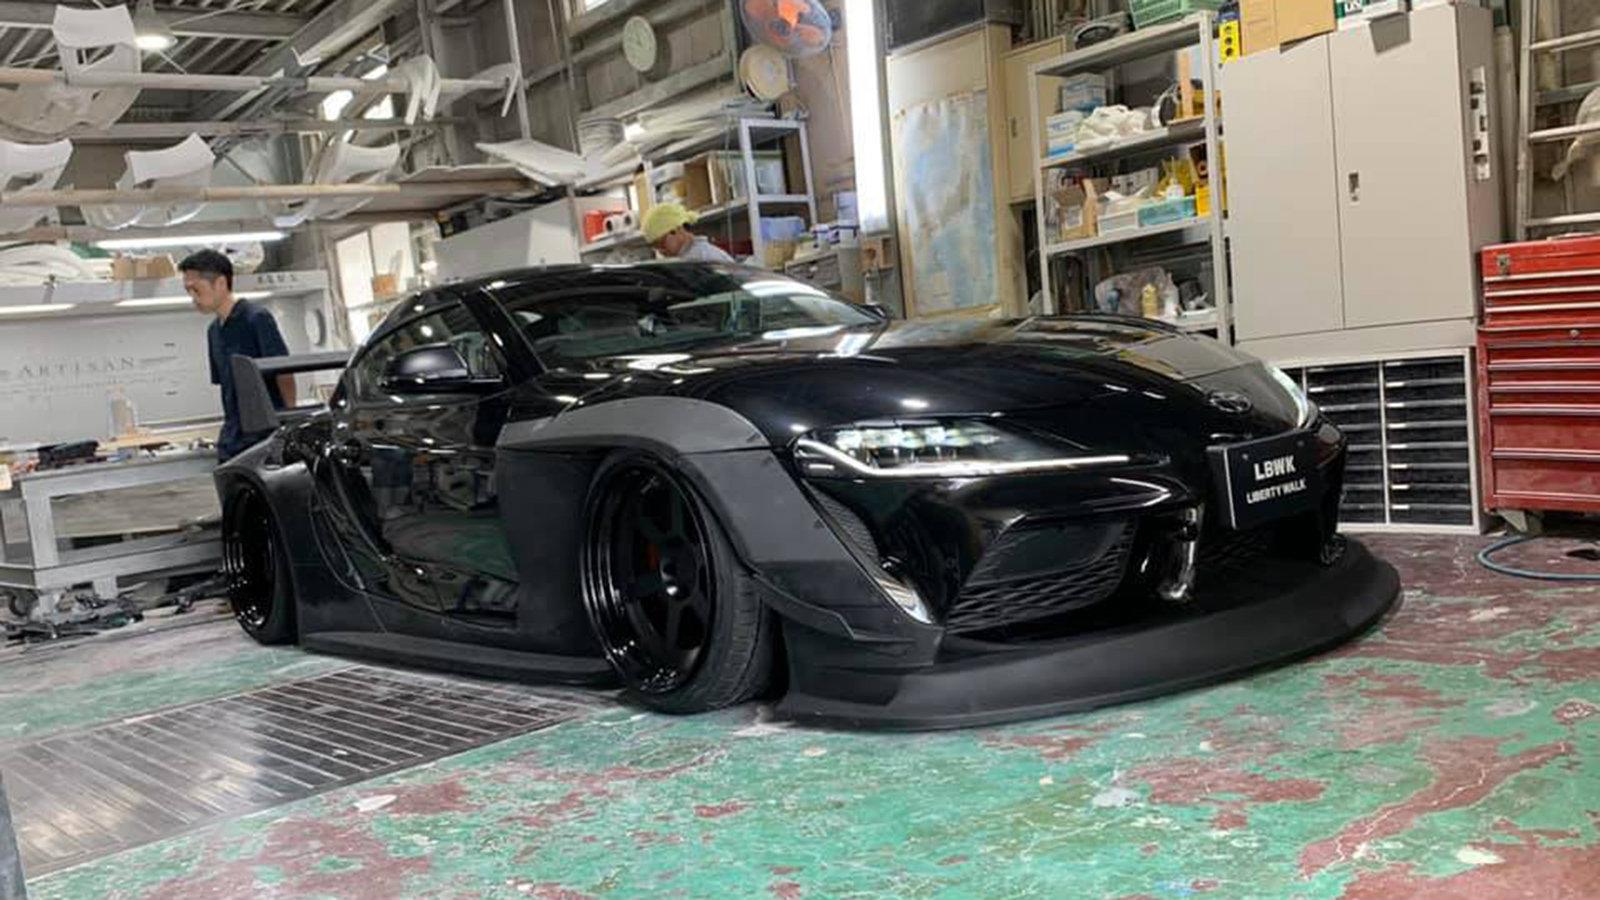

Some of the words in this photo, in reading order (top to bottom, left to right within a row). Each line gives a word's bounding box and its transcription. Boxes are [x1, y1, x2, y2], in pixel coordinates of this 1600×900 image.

[18, 357, 135, 378] ARTISAN
[1254, 455, 1295, 481] LBWK
[1246, 485, 1282, 504] LIBERTY
[1282, 478, 1307, 495] WALK
